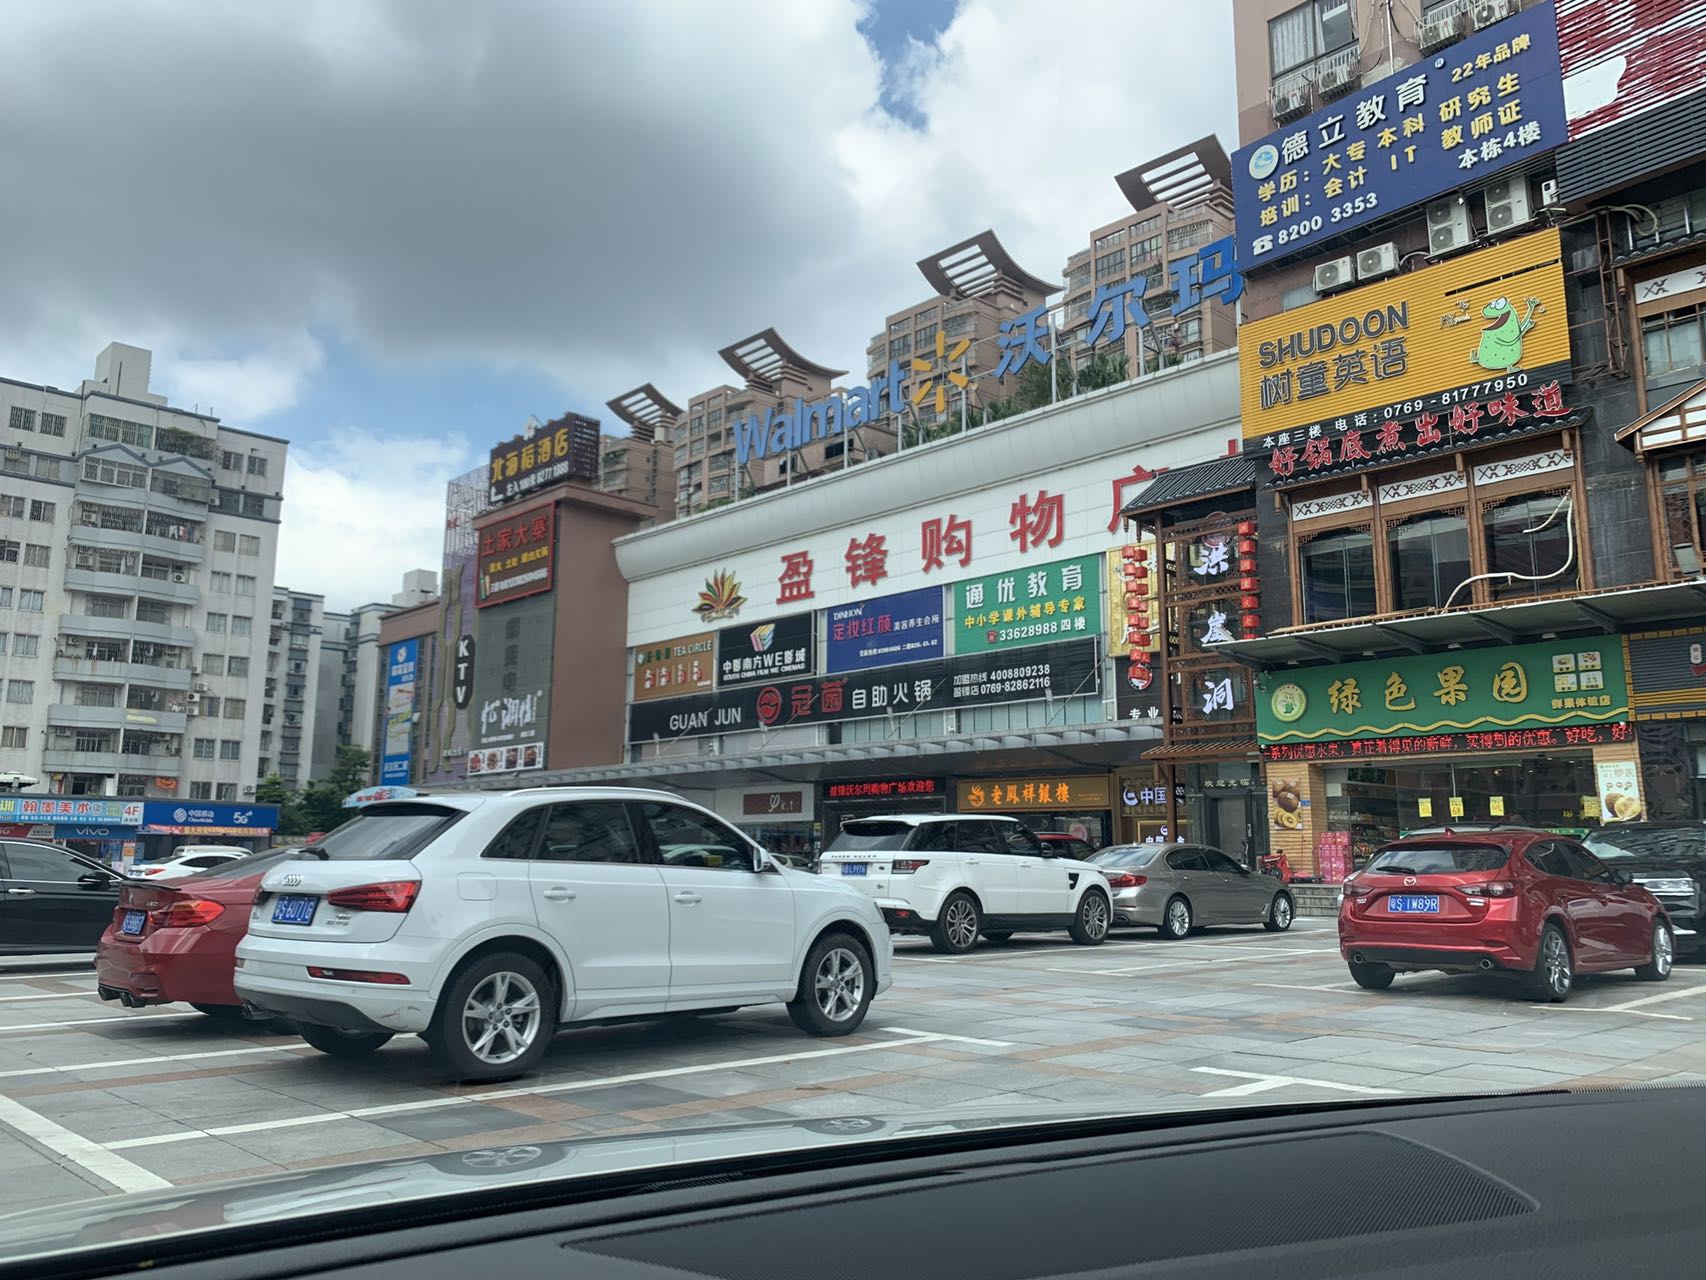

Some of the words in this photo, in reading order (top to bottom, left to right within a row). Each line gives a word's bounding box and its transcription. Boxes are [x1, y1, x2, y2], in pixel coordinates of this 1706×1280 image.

[1452, 33, 1532, 83] 22年品牌
[1281, 73, 1428, 165] 德立教育
[1322, 140, 1366, 175] 大专
[1377, 113, 1426, 149] 本科
[1439, 72, 1521, 120] 研究生
[1323, 166, 1367, 199] 会计
[1440, 99, 1522, 150] 教师证
[1458, 120, 1542, 170] 本栋4楼
[1277, 215, 1323, 245] 8200
[1330, 192, 1378, 224] 3353
[991, 234, 1245, 378] 沃尔玛
[1258, 300, 1409, 369] SHUDOON
[1259, 335, 1409, 411] 树童英语
[733, 360, 906, 465] Walmart
[1262, 424, 1323, 449] 本座三楼
[1267, 379, 1575, 476] 好锅底煮出好味道
[776, 439, 1238, 605] 盈锋购物广
[965, 564, 1082, 610] 通优教育
[832, 613, 892, 641] 定妆红颜
[893, 614, 940, 631] 美容养生会所
[964, 595, 1086, 630] 中小学课外辅导专家
[999, 621, 1058, 642] 33628988
[1060, 616, 1086, 632] 四楼
[456, 639, 469, 704] KTV
[673, 646, 686, 657] TEA
[688, 640, 712, 655] CIRCLE
[723, 648, 806, 674] 中影南方WE影城
[740, 670, 756, 679] CHINA
[757, 668, 769, 676] FILM
[770, 666, 779, 674] WE
[780, 663, 806, 672] CINEMAS
[953, 672, 987, 685] 加盟热线
[989, 664, 1050, 681] 4008809238
[980, 677, 1050, 695] 0769-82862116
[1327, 661, 1529, 716] 绿色果园
[669, 710, 708, 732] GUAN
[714, 706, 742, 727] JUN
[851, 680, 932, 710] 自助火锅
[1203, 778, 1250, 788] 欢迎光临
[75, 825, 110, 836] vivo
[125, 806, 140, 816] 4F
